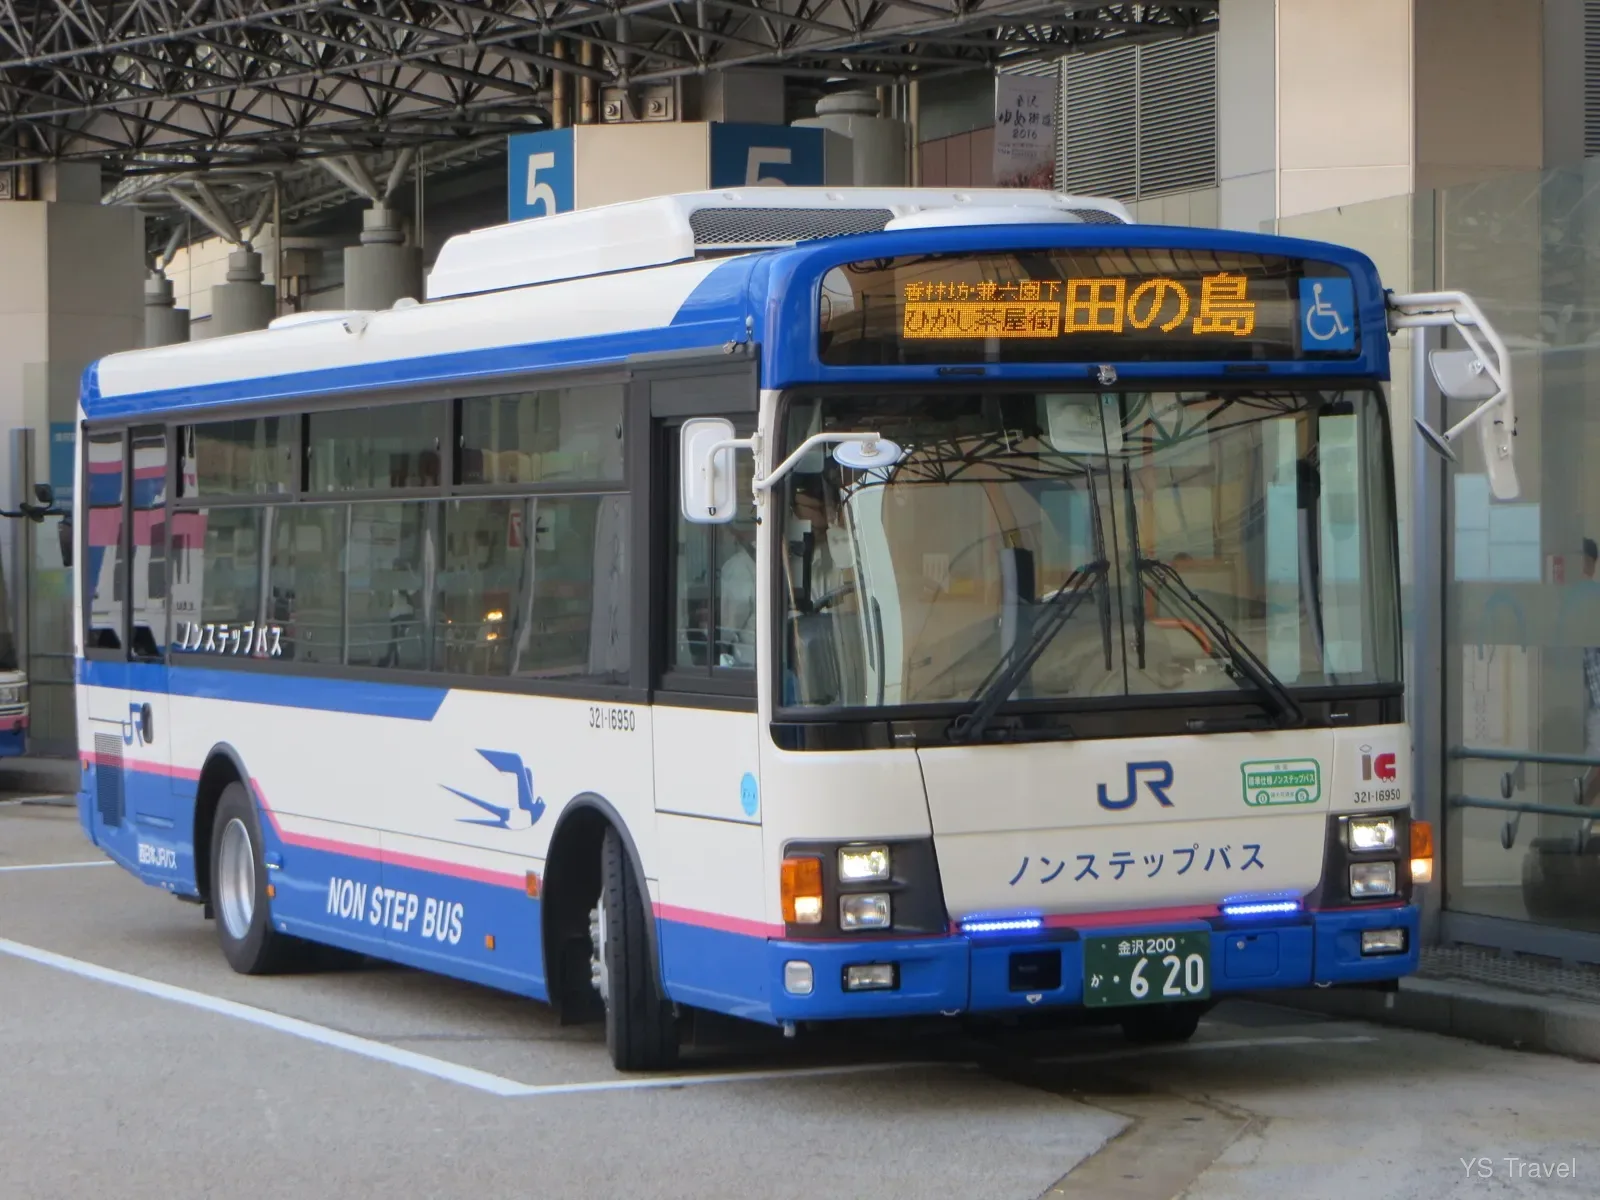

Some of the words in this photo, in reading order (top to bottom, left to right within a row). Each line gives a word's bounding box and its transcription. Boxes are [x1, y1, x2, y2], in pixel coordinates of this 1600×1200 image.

[1012, 129, 1038, 140] 2016
[904, 305, 1060, 334] ひがし茶屋街
[1064, 272, 1255, 337] 田の島
[182, 620, 282, 656] ノンステップバス
[589, 706, 636, 732] 321-16950
[1096, 760, 1176, 811] JR
[1353, 788, 1401, 804] 321-16950
[1008, 843, 1265, 886] ノンステップバス
[327, 876, 368, 922] NON
[369, 886, 419, 933] STEP
[421, 897, 464, 945] BUS
